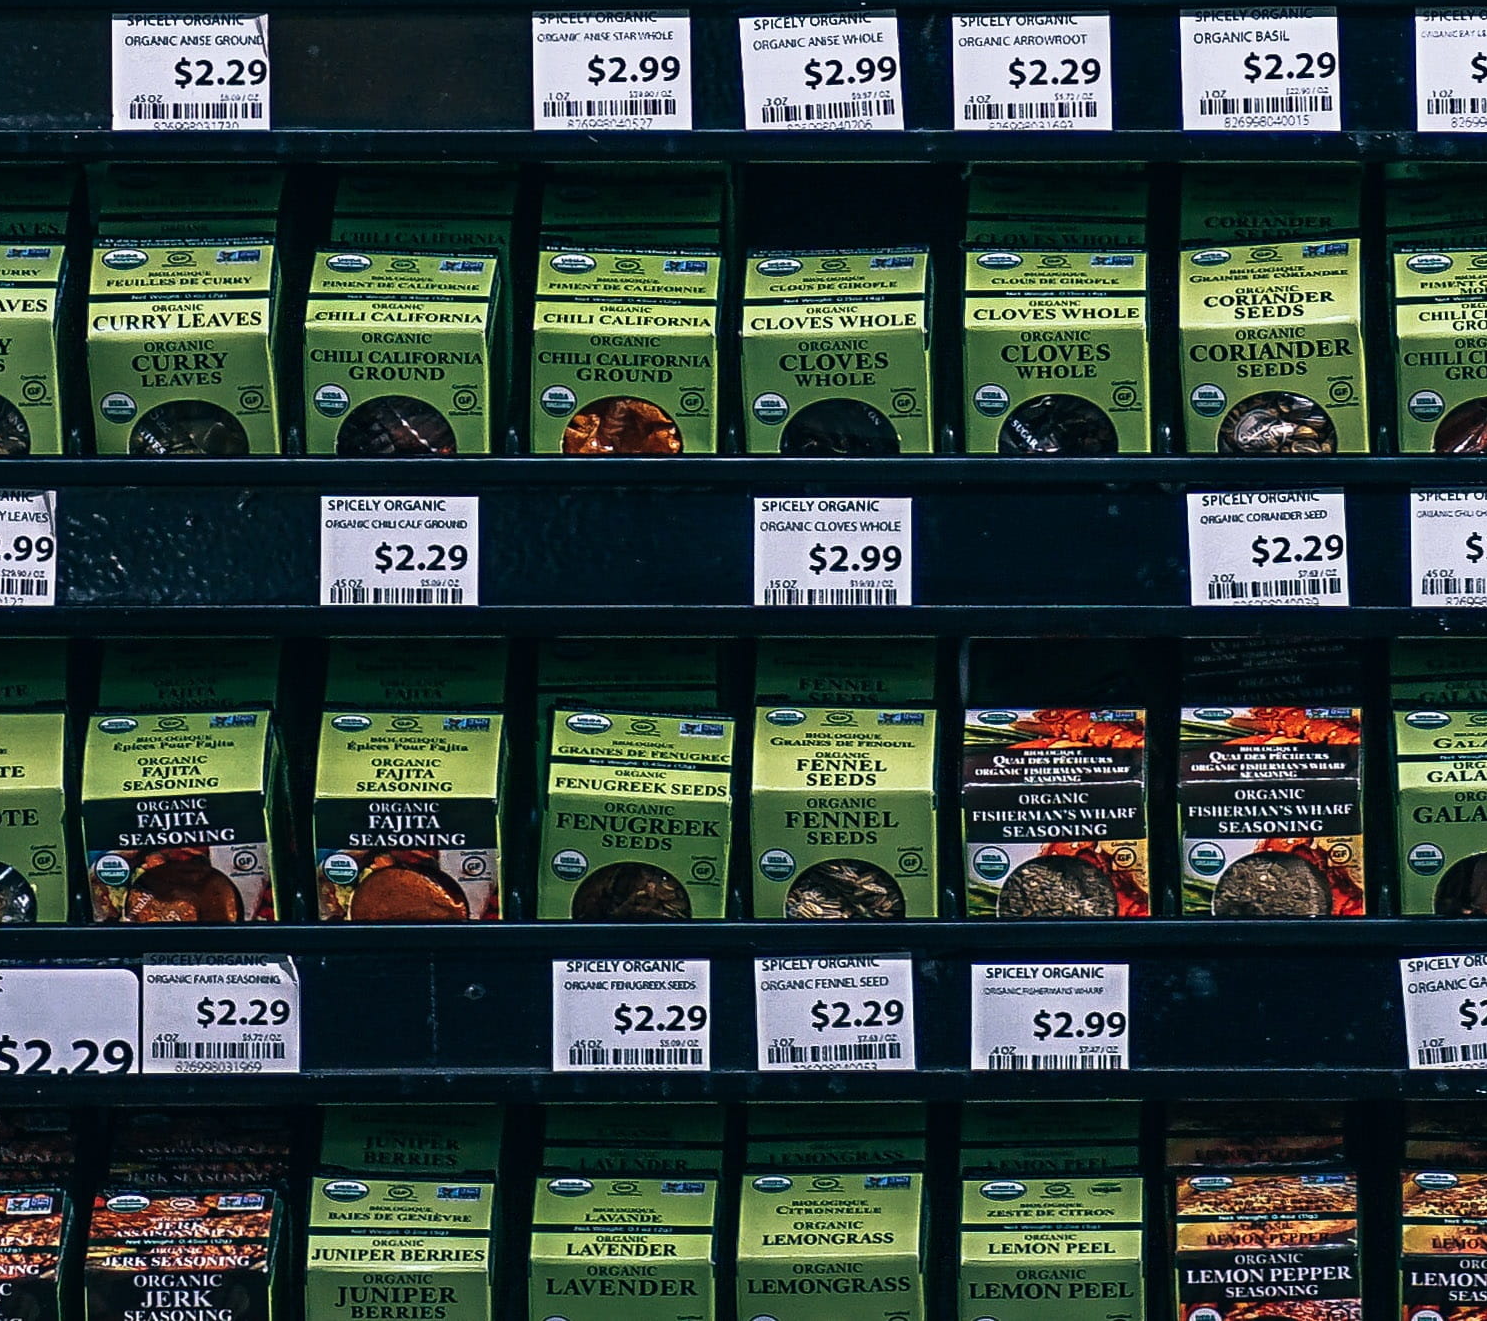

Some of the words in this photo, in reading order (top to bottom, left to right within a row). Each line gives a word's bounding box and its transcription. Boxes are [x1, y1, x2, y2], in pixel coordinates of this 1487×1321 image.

[1244, 52, 1335, 83] $2.29
[1190, 339, 1353, 362] CORIANDER
[779, 352, 888, 371] CLOVES
[1189, 806, 1292, 816] FISHERMAN'S
[1296, 804, 1352, 815] WHARF
[369, 816, 440, 832] FAJITA
[556, 813, 721, 837] FENUGREEK
[811, 1000, 903, 1032] $2.29
[546, 1278, 698, 1296] LAVENDER
[747, 1277, 911, 1294] LEMONGRASS
[335, 1286, 458, 1307] JUNIPER
